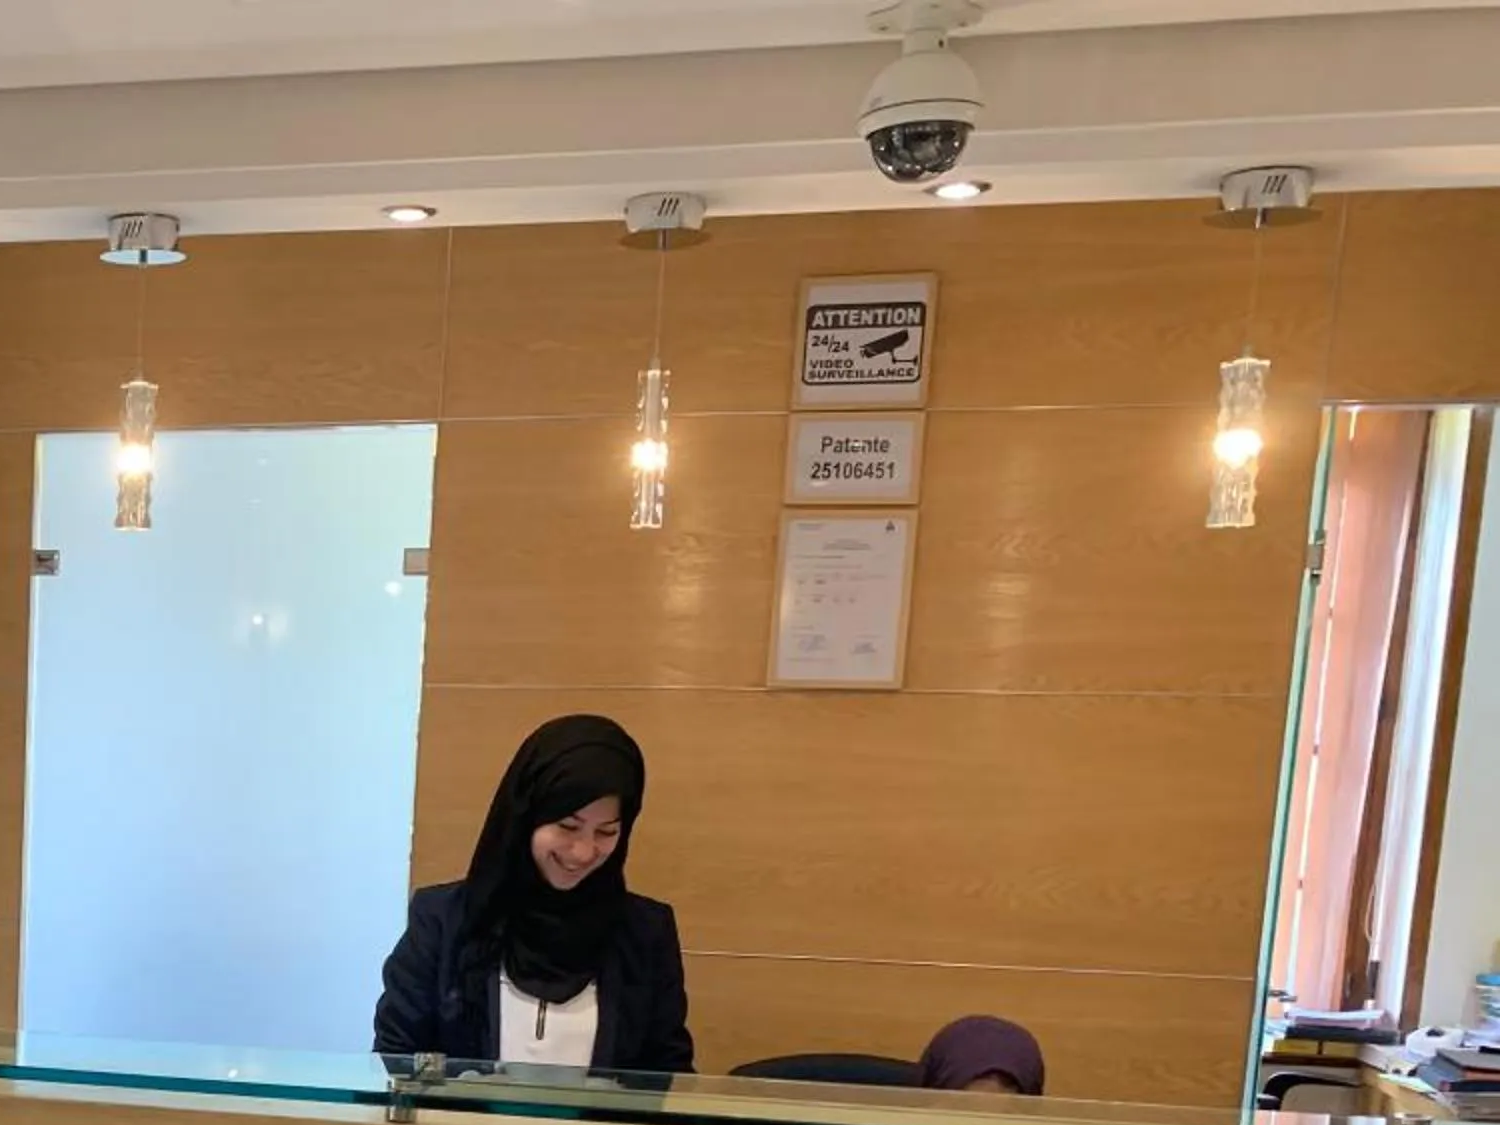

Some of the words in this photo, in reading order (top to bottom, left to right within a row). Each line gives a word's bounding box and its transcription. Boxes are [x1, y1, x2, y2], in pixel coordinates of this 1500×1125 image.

[811, 306, 921, 328] ATTENTION
[811, 333, 850, 354] 24/24
[807, 367, 916, 379] SURVEILLANCE
[809, 359, 854, 369] VIDEO
[820, 435, 891, 454] Patente
[810, 461, 896, 480] 25106451
